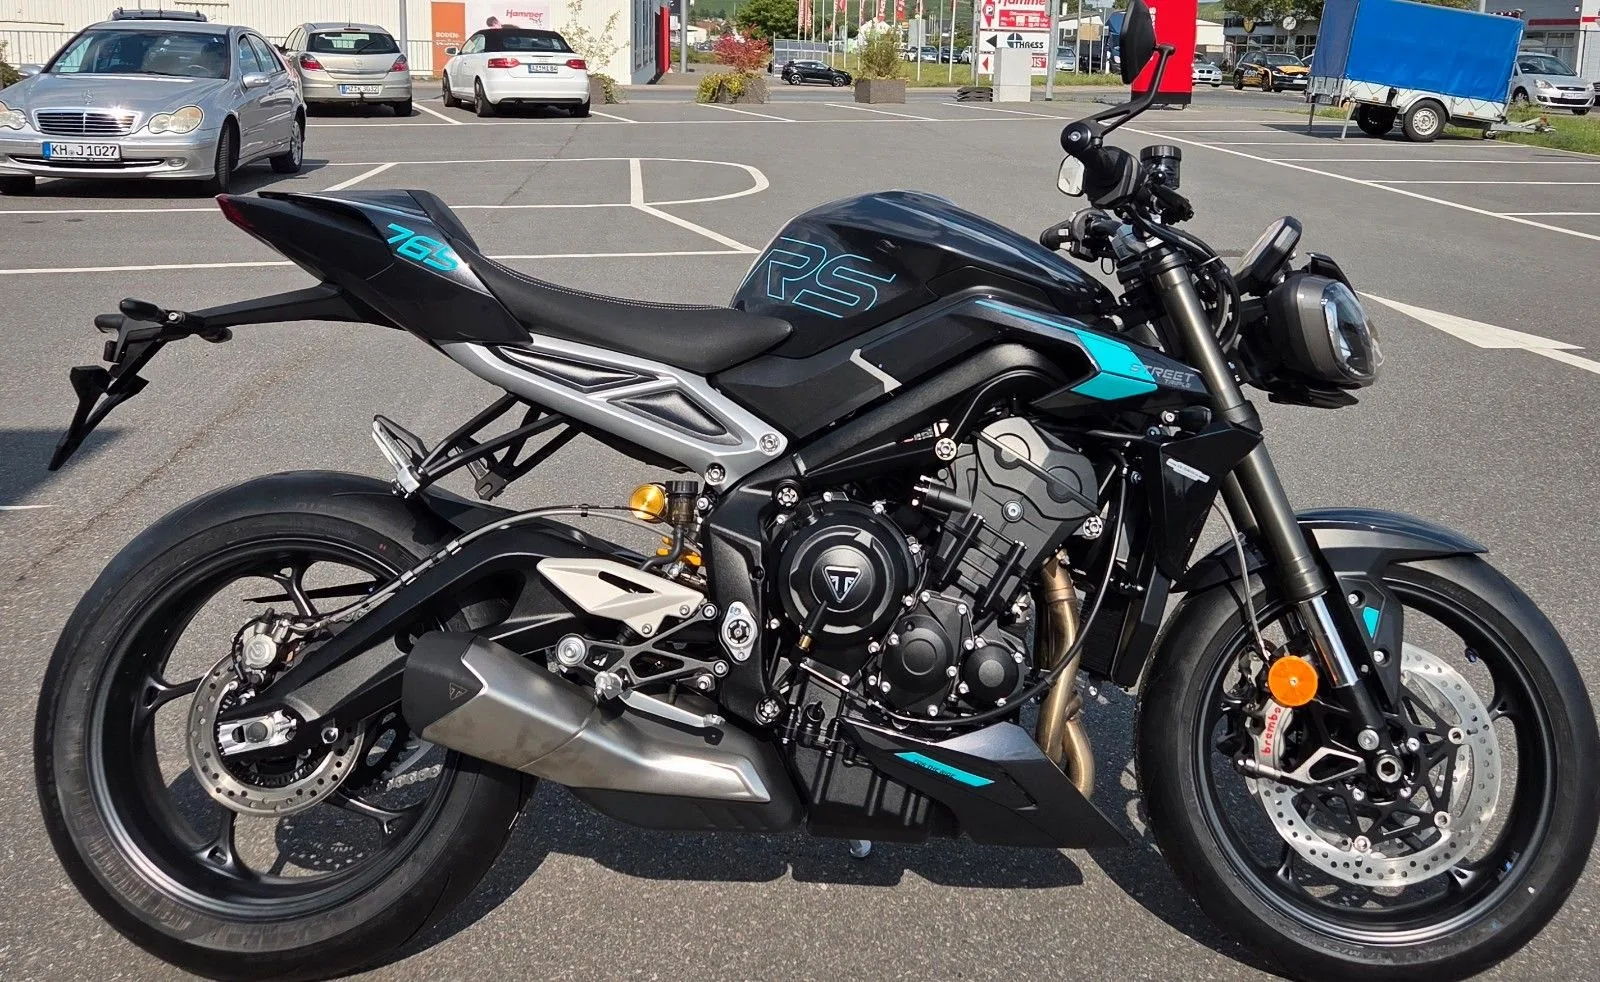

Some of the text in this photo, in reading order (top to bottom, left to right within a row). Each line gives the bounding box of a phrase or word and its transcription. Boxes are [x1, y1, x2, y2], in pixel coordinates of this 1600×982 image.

[506, 9, 543, 18] Hammer
[51, 144, 68, 155] KH
[86, 145, 117, 157] 1027
[387, 223, 459, 272] 765
[741, 236, 897, 319] RS
[1131, 364, 1195, 383] STREET
[1260, 706, 1281, 755] brembo
